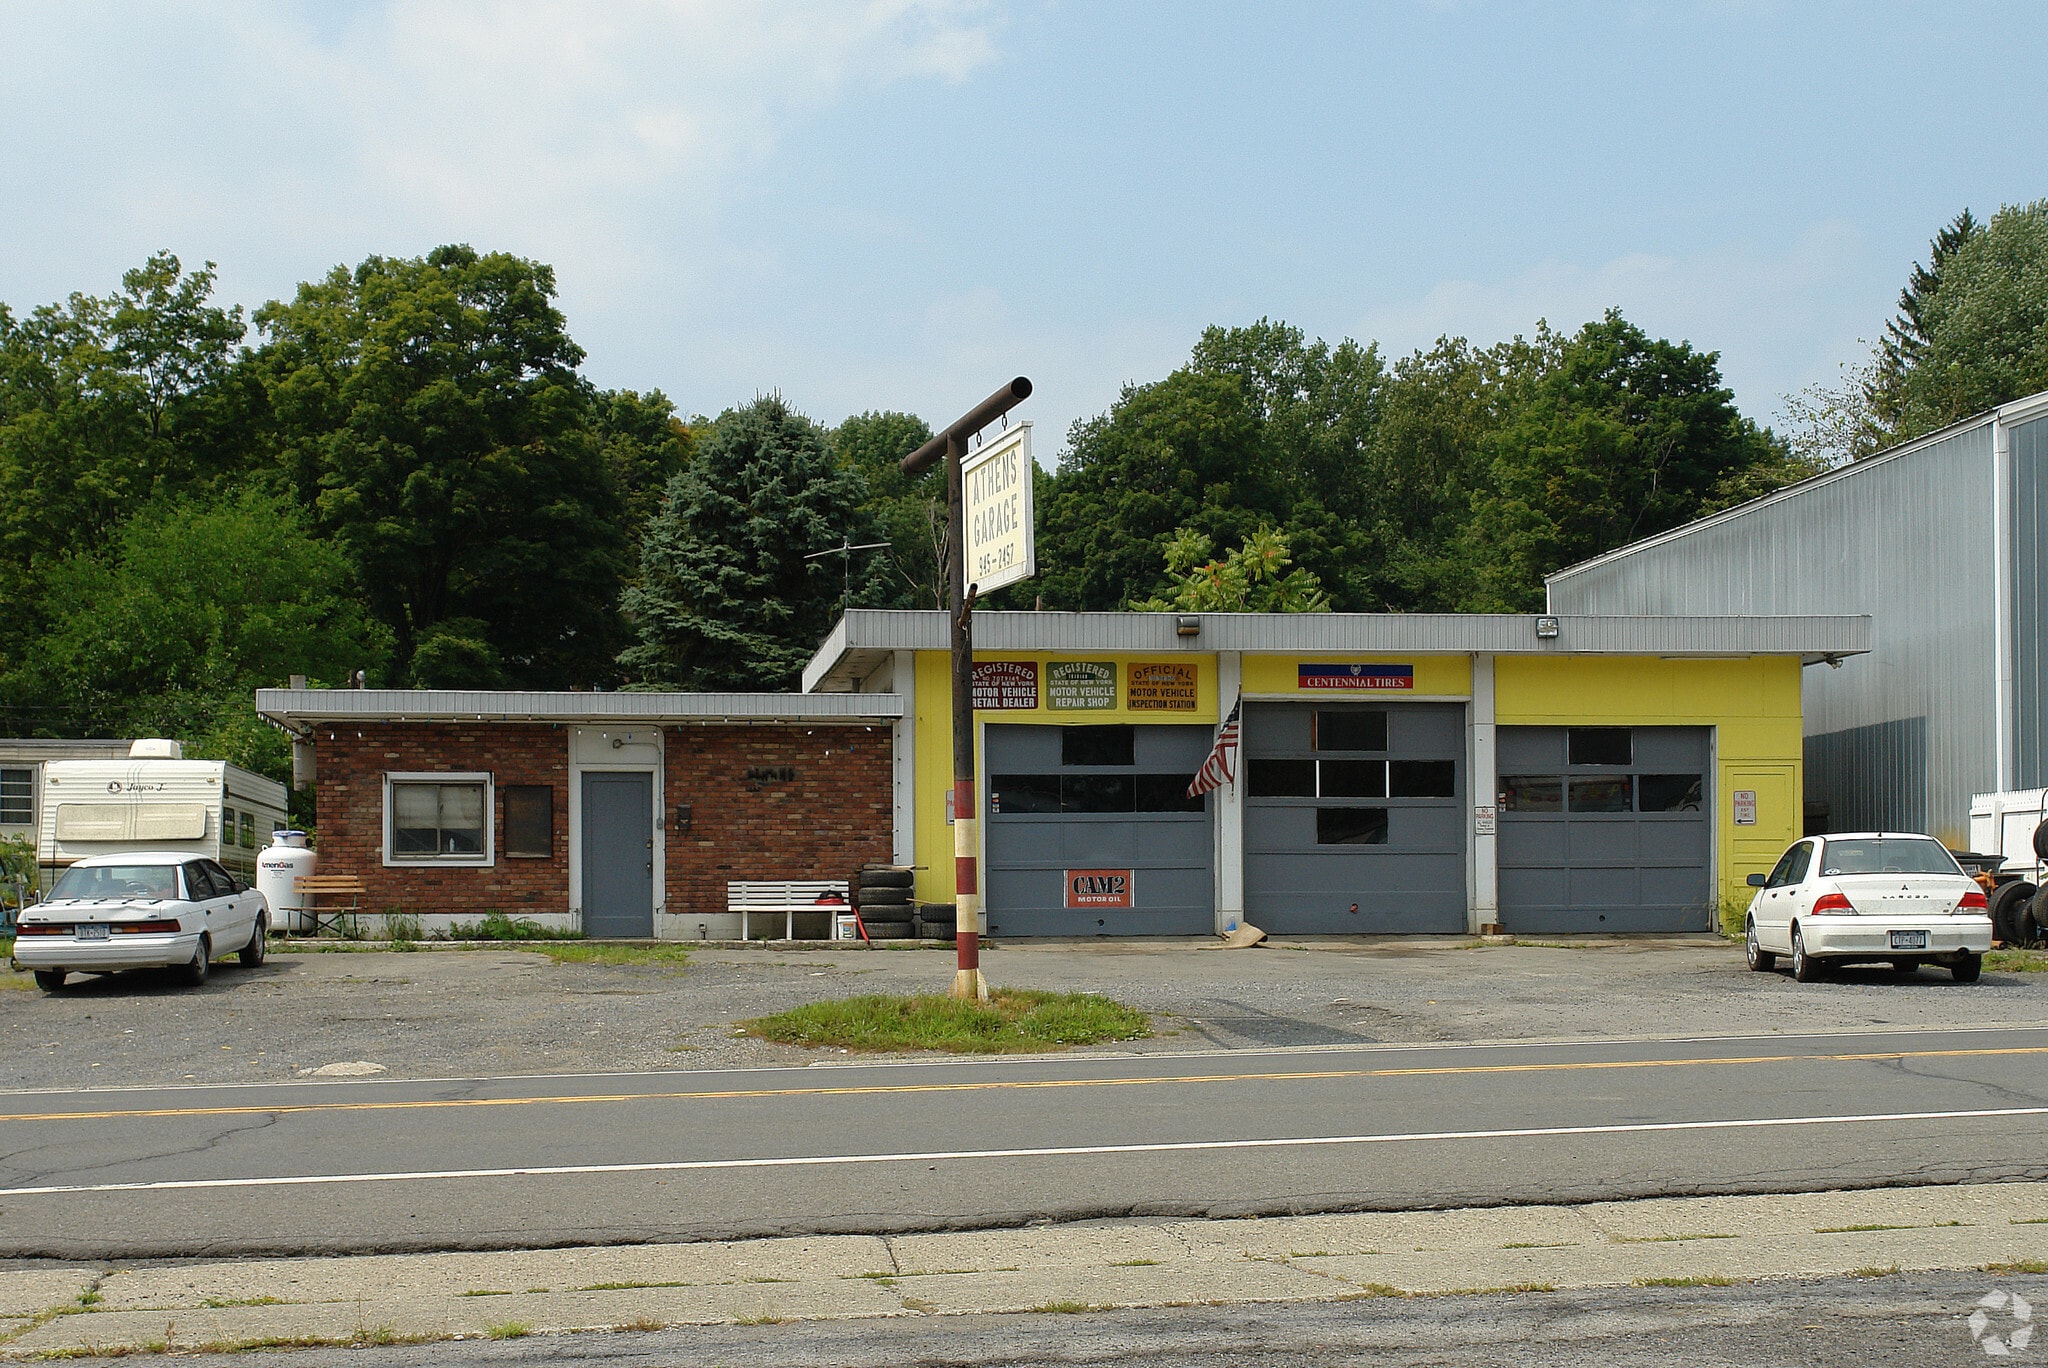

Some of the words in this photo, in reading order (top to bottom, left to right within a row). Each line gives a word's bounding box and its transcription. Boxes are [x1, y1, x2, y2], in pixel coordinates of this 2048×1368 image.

[973, 449, 1017, 507] ATHENS
[974, 493, 1018, 547] GARAGE
[972, 663, 1034, 680] REGISTERED
[1053, 663, 1110, 679] REGISTERED
[1134, 665, 1192, 680] OFFICIAL
[1307, 678, 1374, 687] CENTENNIAL
[1375, 678, 1405, 687] TIRES
[1001, 687, 1036, 697] VEHICLE
[1050, 687, 1077, 697] MOTOR
[1080, 687, 1115, 697] VEHICLE
[1130, 688, 1158, 697] MOTOR
[1160, 688, 1195, 697] VEHICLE
[1002, 698, 1035, 708] DEALER
[1056, 698, 1085, 707] REPAIR
[1087, 698, 1110, 707] SHOP
[1129, 700, 1167, 709] INSPECTION
[1169, 700, 1195, 709] STATION
[126, 783, 154, 792] Jayco
[1072, 875, 1126, 894] CAM2
